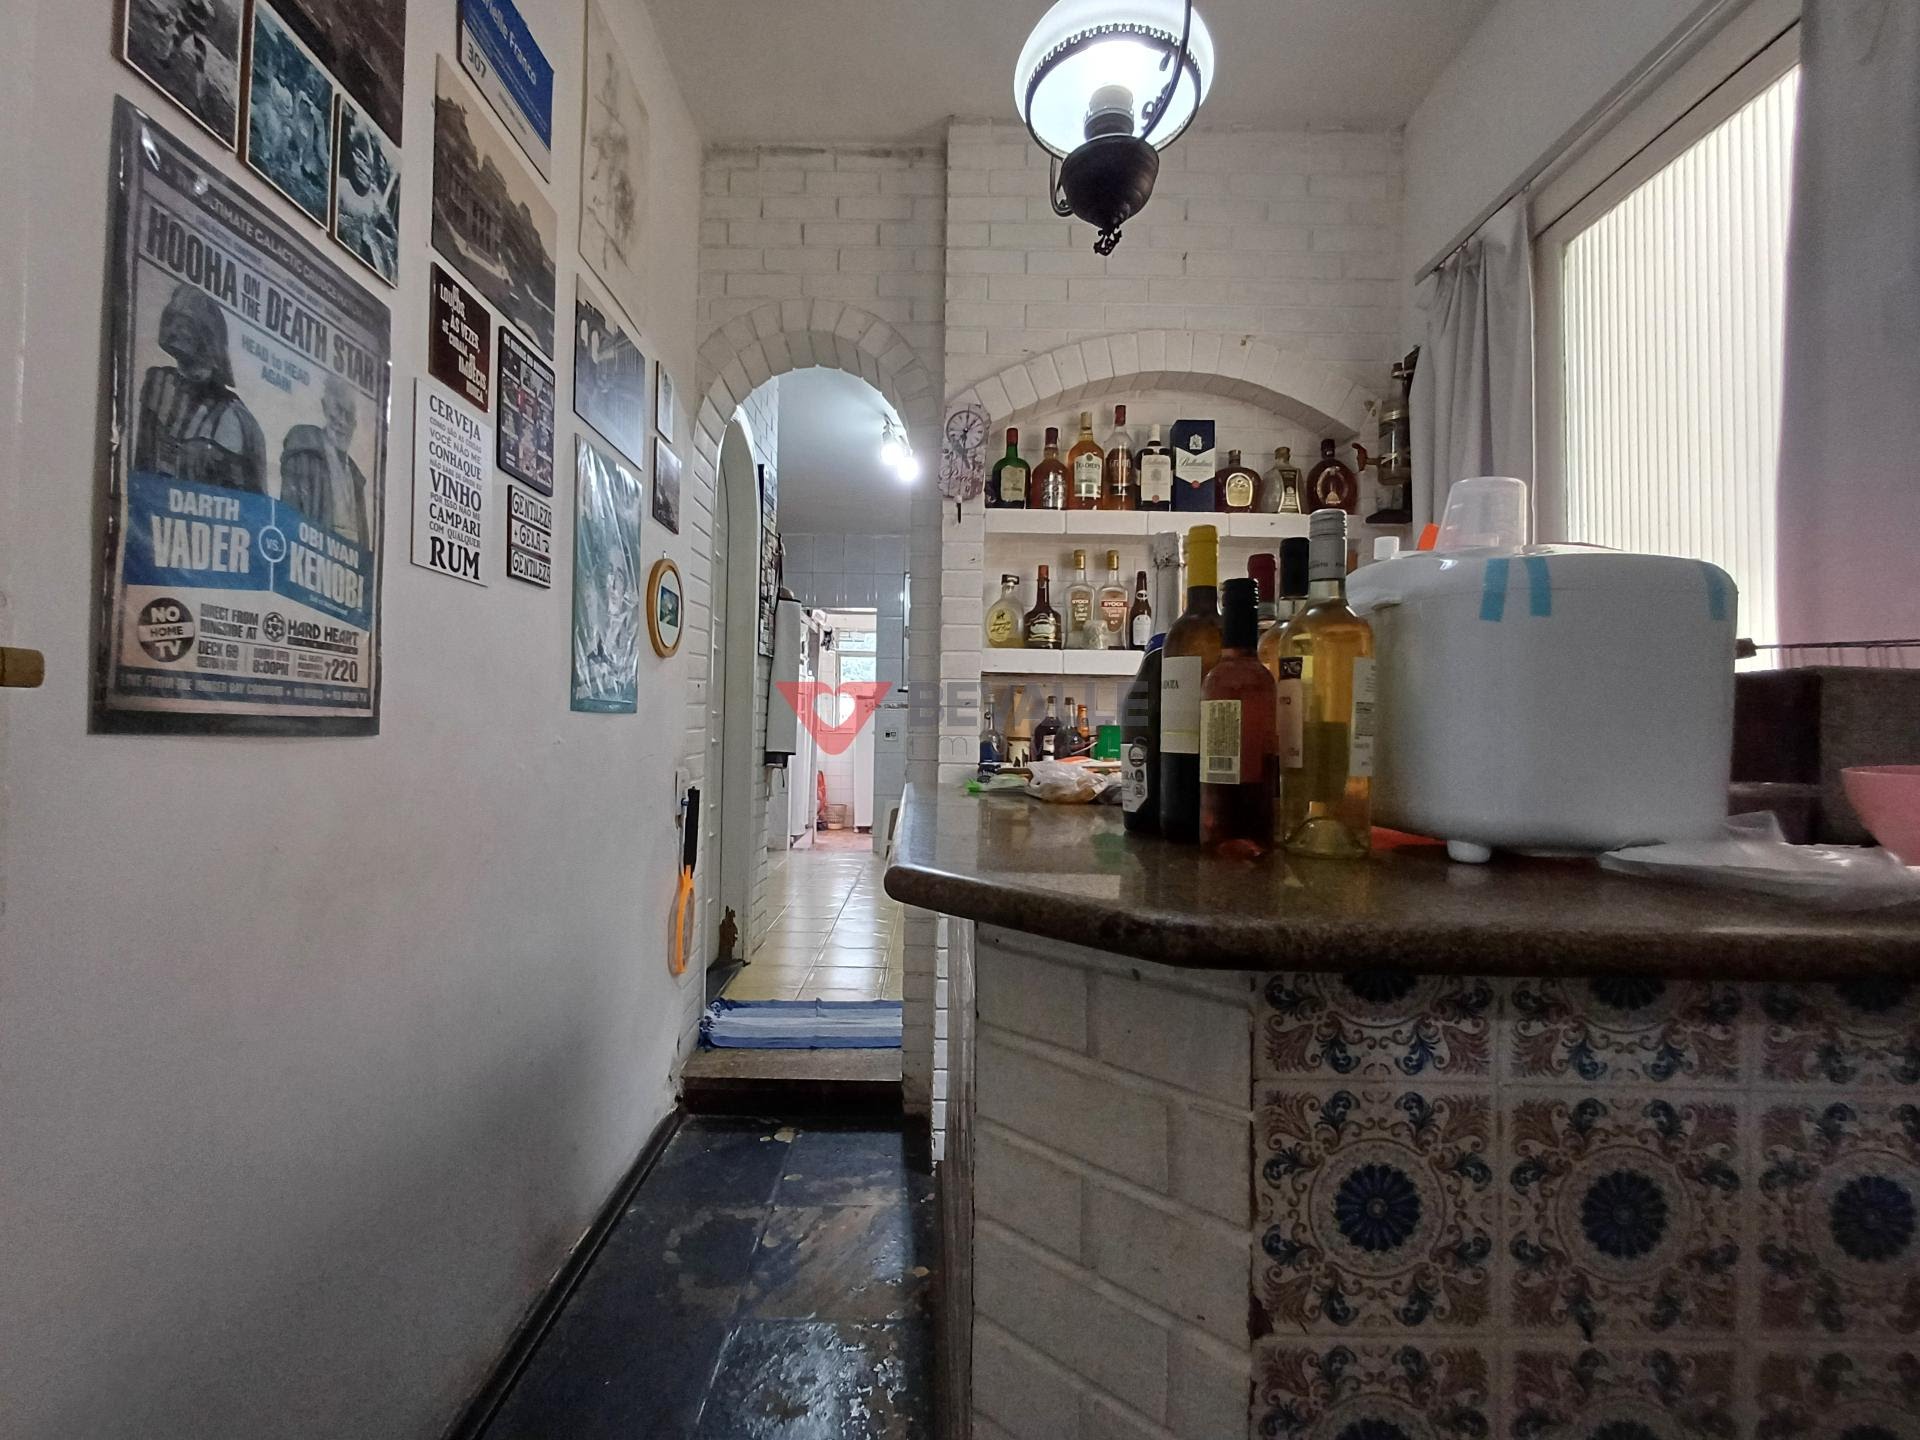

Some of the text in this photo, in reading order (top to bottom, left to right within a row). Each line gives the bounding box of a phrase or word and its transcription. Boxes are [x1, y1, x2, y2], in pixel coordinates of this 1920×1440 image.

[467, 42, 487, 79] 307
[509, 31, 537, 85] Franco
[147, 204, 238, 307] HOOHA
[244, 273, 261, 298] ON
[241, 298, 260, 322] THE
[264, 286, 328, 363] DEATH
[333, 334, 375, 394] STAR
[429, 394, 481, 441] CERVEJA
[429, 427, 481, 464] VOCÊ NÃO ME
[429, 441, 482, 480] CONHAQUE
[169, 488, 240, 521] DARTH
[429, 467, 481, 512] VINHO
[430, 492, 443, 504] POR
[445, 497, 457, 511] ISSO
[429, 503, 481, 538] CAMPARI
[512, 491, 551, 530] GENTILEZA
[151, 516, 250, 573] VADER
[300, 522, 359, 569] OBI WAN
[429, 520, 481, 549] COM QUALQUER
[290, 541, 364, 609] KENOBI
[429, 536, 480, 579] RUM
[512, 552, 551, 582] GENTILEZA
[150, 625, 183, 637] HOME
[151, 606, 181, 623] NO
[288, 619, 321, 639] HARD
[324, 624, 359, 646] HEART
[155, 641, 183, 657] TV
[198, 640, 223, 656] DECK
[246, 627, 257, 640] AT
